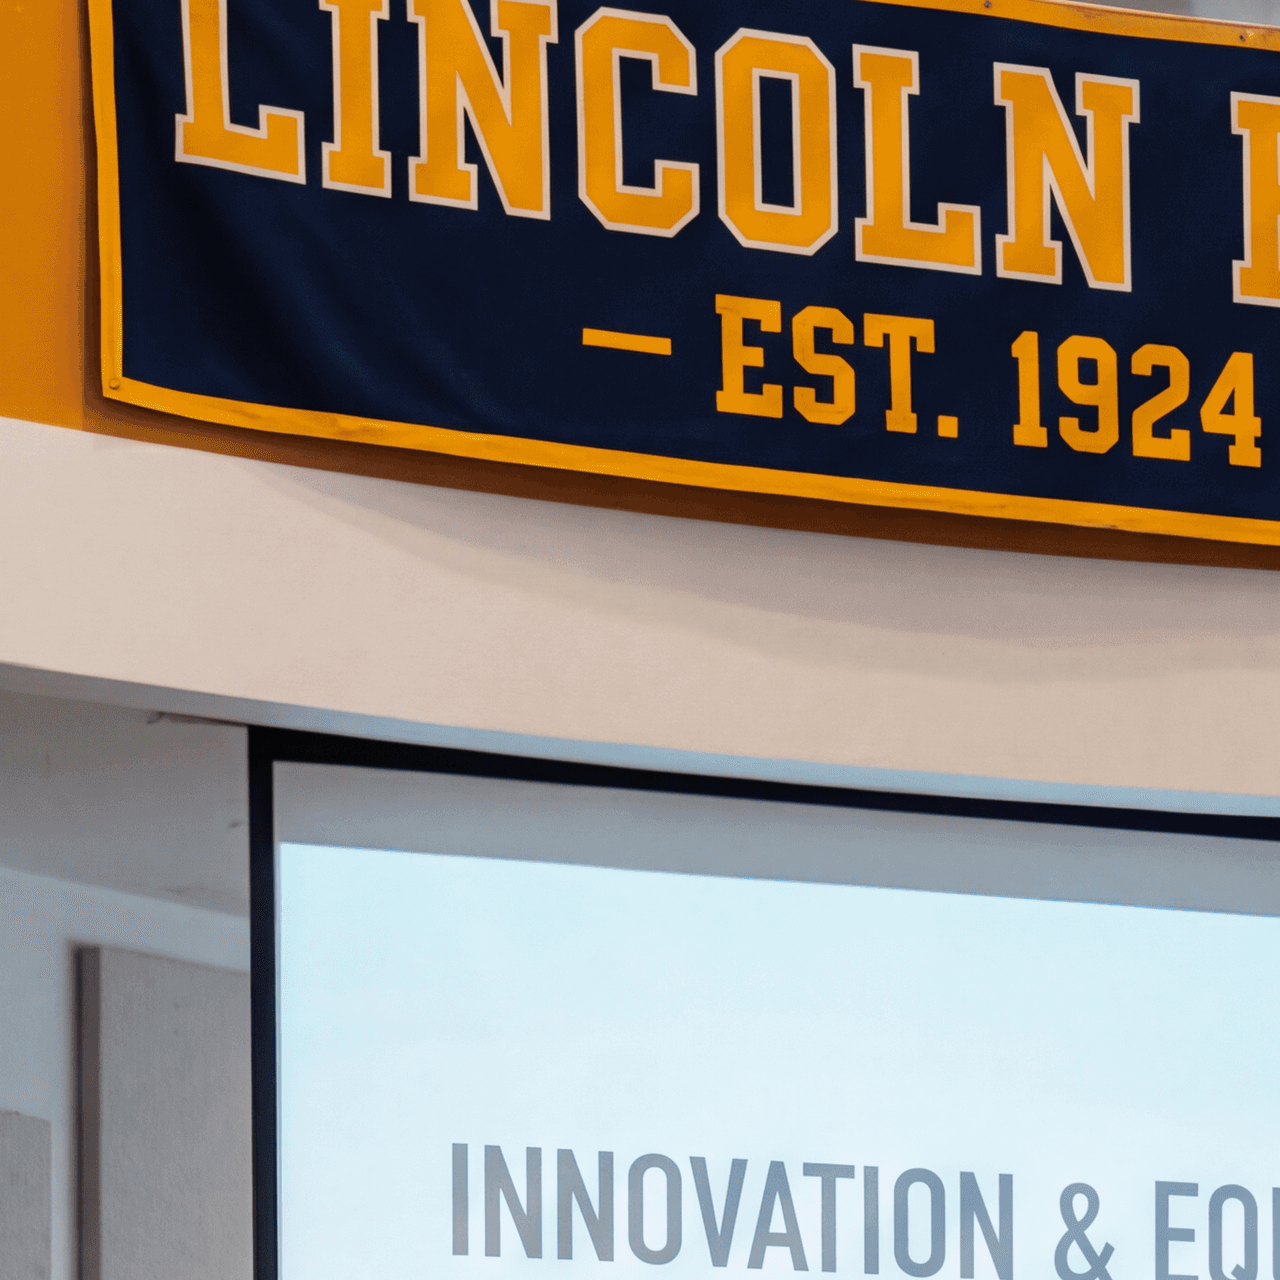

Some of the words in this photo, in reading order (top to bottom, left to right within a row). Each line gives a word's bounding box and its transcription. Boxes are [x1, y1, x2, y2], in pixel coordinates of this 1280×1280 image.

[174, 0, 1141, 293] LINCOLN
[715, 293, 959, 439] EST.
[1011, 330, 1262, 468] 1924
[451, 1142, 1014, 1280] INNOVATION
